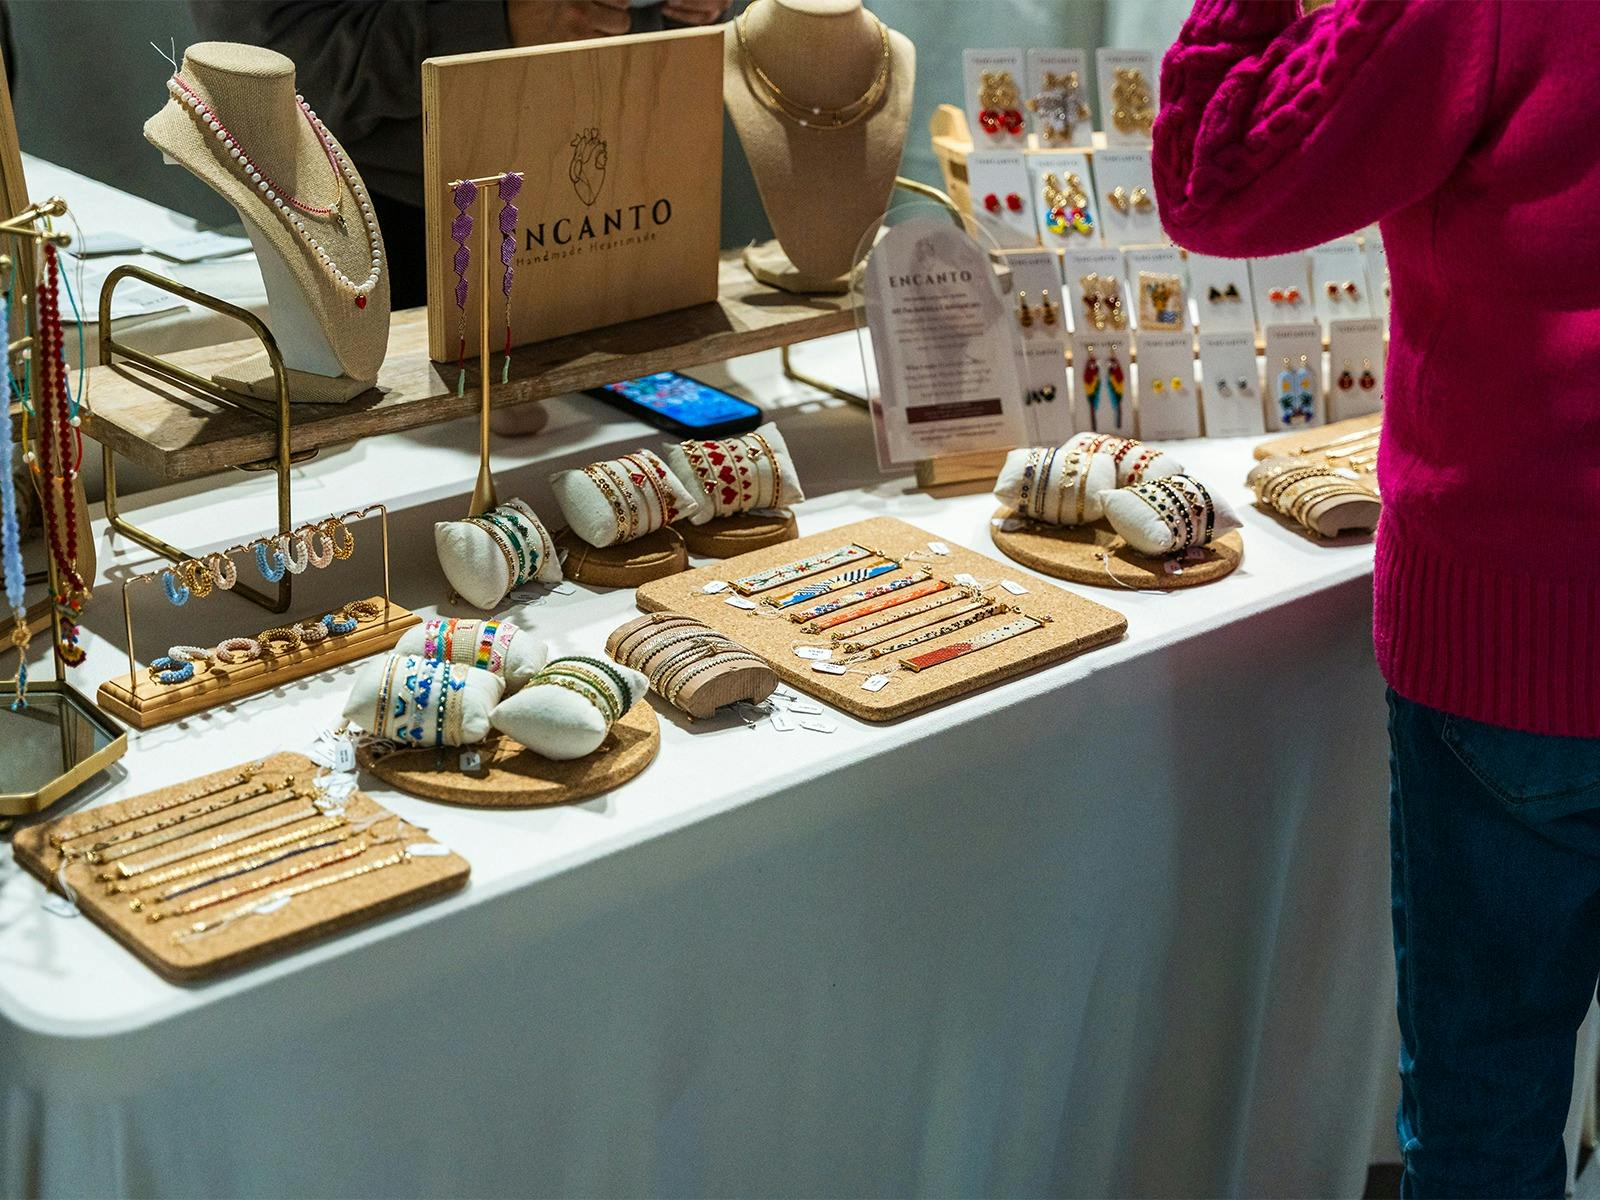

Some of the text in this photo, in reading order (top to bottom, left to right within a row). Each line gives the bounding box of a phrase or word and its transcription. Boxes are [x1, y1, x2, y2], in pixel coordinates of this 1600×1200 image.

[504, 198, 672, 252] NCANTO
[516, 245, 582, 267] Handmade
[889, 270, 973, 288] ENCANTO
